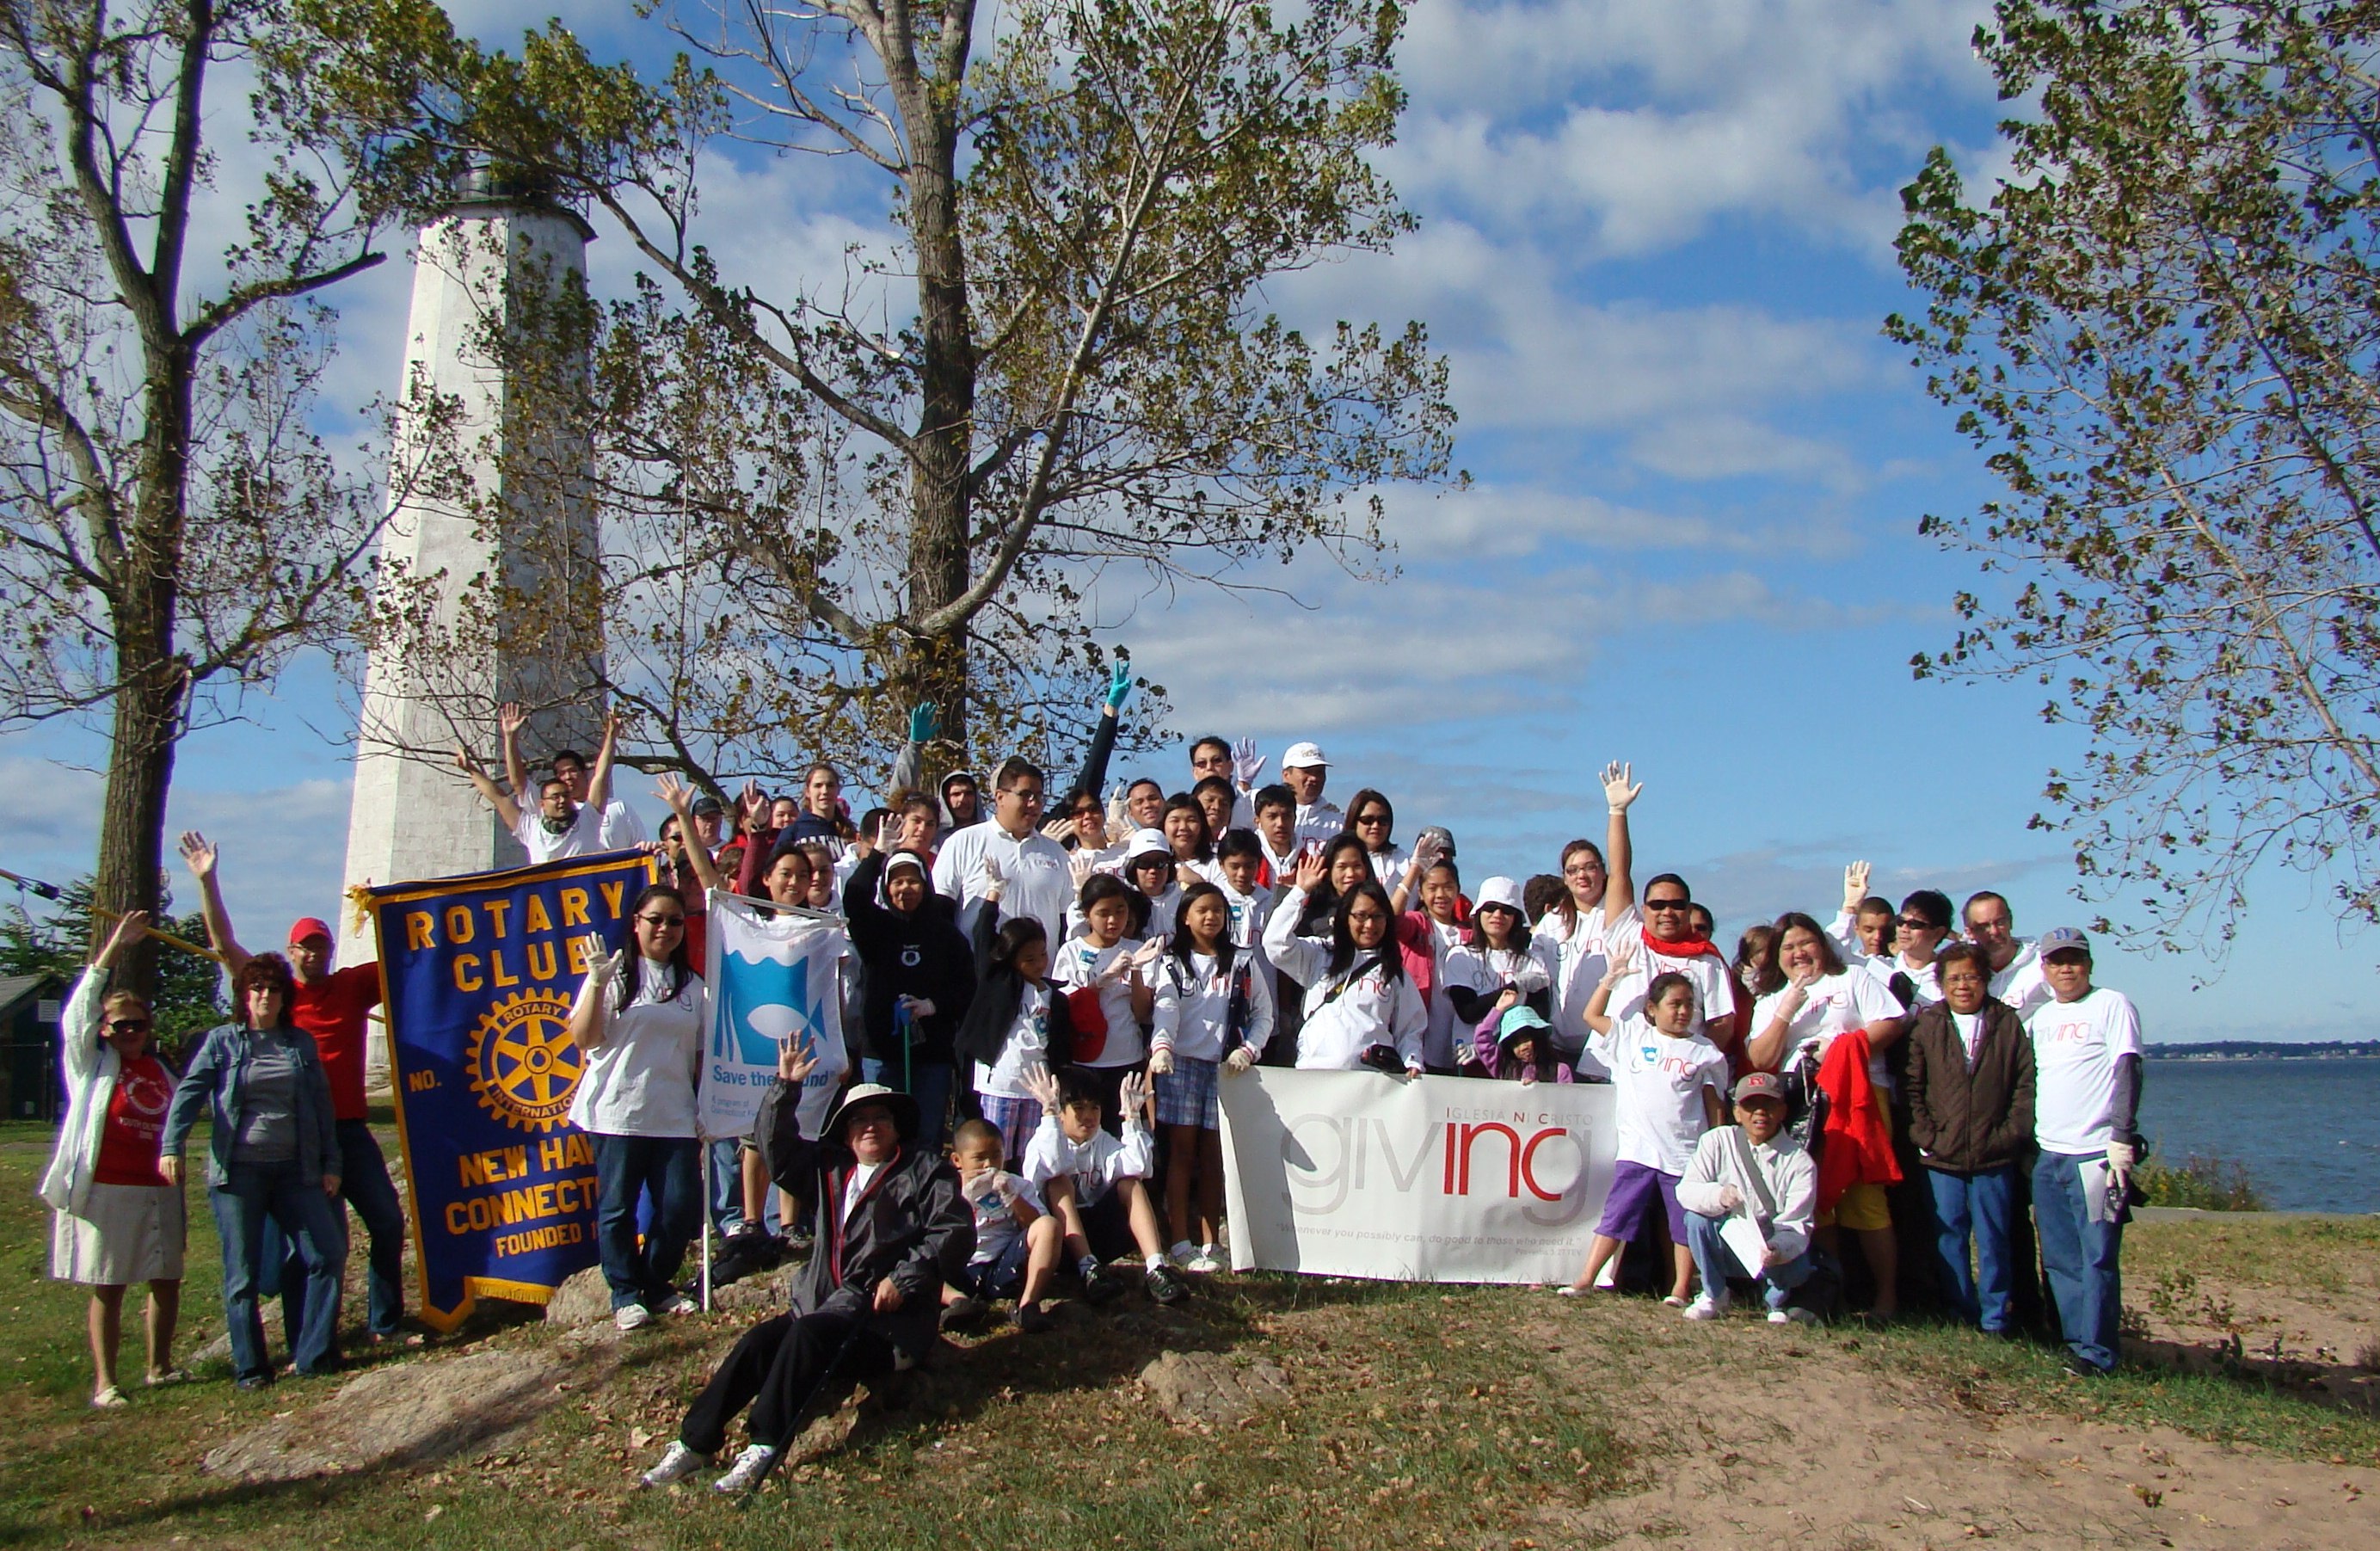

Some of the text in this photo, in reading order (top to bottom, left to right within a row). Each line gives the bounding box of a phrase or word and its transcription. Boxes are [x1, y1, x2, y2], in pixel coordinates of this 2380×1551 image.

[406, 881, 624, 951] ROTARY
[453, 935, 590, 992] CLUB
[504, 1002, 562, 1024] ROTARY
[409, 1069, 441, 1092] NO.
[713, 1065, 747, 1086] Save
[751, 1072, 775, 1086] the
[492, 1089, 579, 1118] INTERNATIO
[1446, 1107, 1505, 1121] IGLESIA
[1538, 1113, 1593, 1126] CRISTO
[458, 1144, 529, 1189] NEW
[495, 1222, 582, 1259] FOUNDED
[1335, 1229, 1353, 1239] you
[1356, 1230, 1402, 1243] possibly
[1429, 1234, 1442, 1243] do
[1444, 1235, 1471, 1246] good
[1473, 1236, 1484, 1245] to
